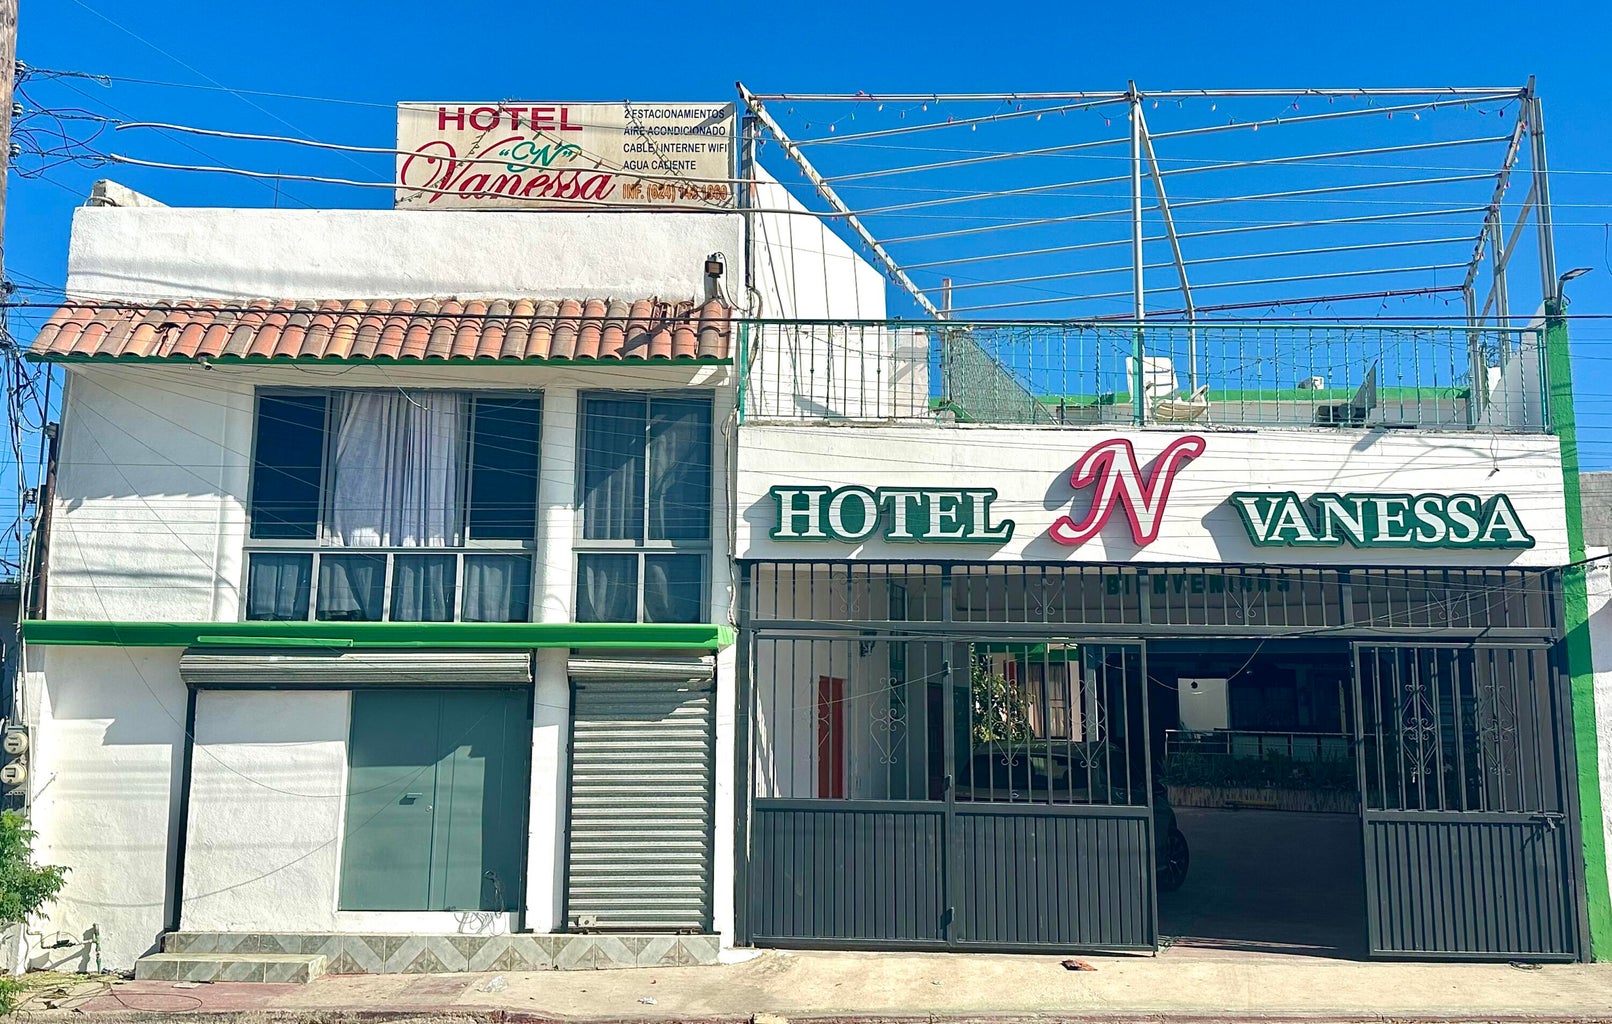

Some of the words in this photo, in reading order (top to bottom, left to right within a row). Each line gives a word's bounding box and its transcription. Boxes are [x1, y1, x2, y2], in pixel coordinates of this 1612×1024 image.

[438, 106, 583, 131] HOTEL
[624, 109, 630, 119] 2
[632, 109, 725, 119] ESTACIONAMIENTOS
[623, 126, 645, 136] AIRE
[647, 126, 726, 136] ACONDICIONADO
[660, 143, 706, 153] INTERNET
[708, 143, 728, 153] WIFI
[400, 136, 616, 204] Vanessa
[623, 160, 649, 170] AGUA
[651, 160, 697, 170] CALIENTE
[622, 183, 645, 200] INF.
[646, 183, 676, 203] (624)
[769, 485, 1015, 544] HOTEL
[1228, 490, 1536, 550] VANESSA
[1106, 574, 1291, 596] BINVENIDOS
